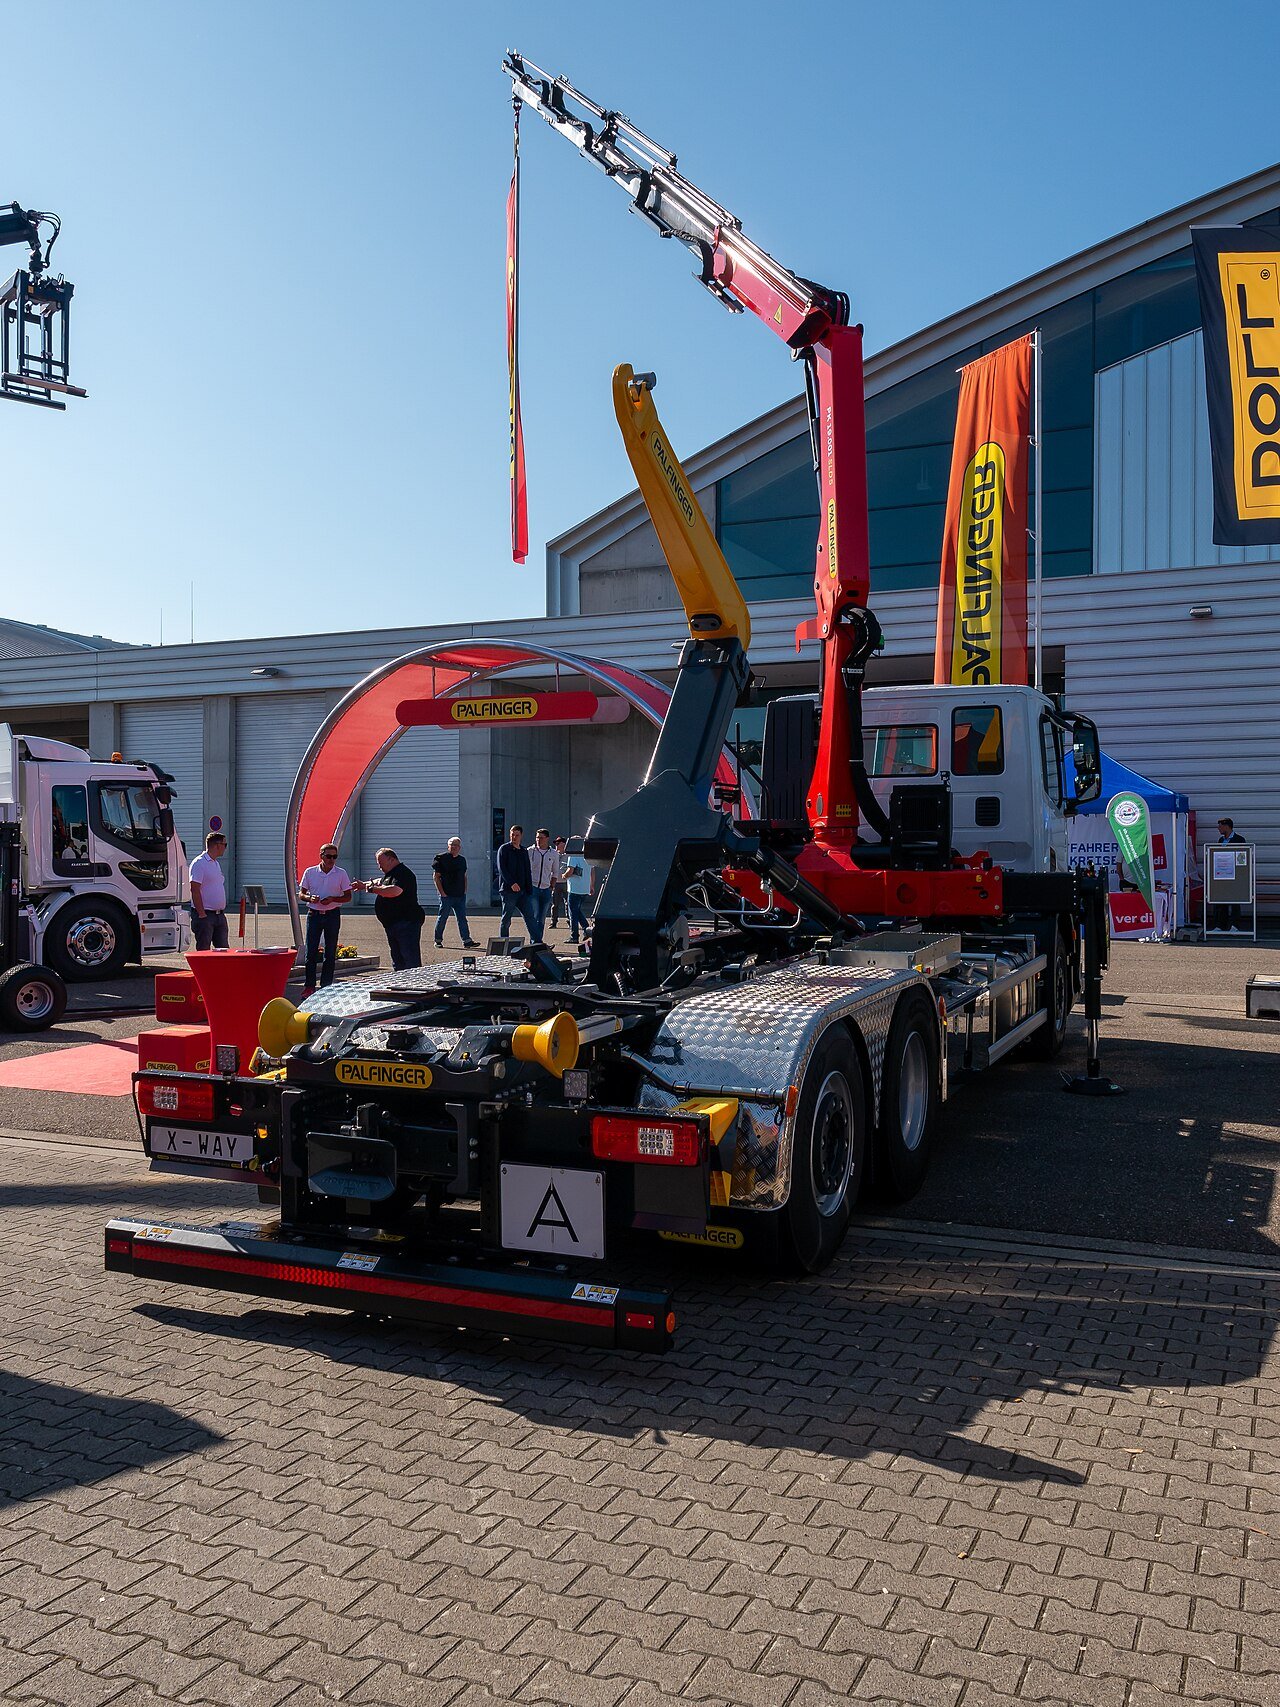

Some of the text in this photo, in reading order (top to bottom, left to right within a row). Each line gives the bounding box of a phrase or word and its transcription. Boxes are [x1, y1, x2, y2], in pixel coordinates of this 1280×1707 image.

[1236, 284, 1280, 488] DOLL
[826, 407, 833, 422] PK
[654, 437, 694, 522] PALFINGER
[829, 504, 837, 574] PALFINGER
[457, 701, 532, 717] PALFINGER
[1067, 843, 1119, 852] FAHRER
[147, 1062, 177, 1071] PALFINGER
[341, 1063, 426, 1085] PALFINGER
[167, 1130, 238, 1157] X-WAY
[526, 1179, 580, 1243] A
